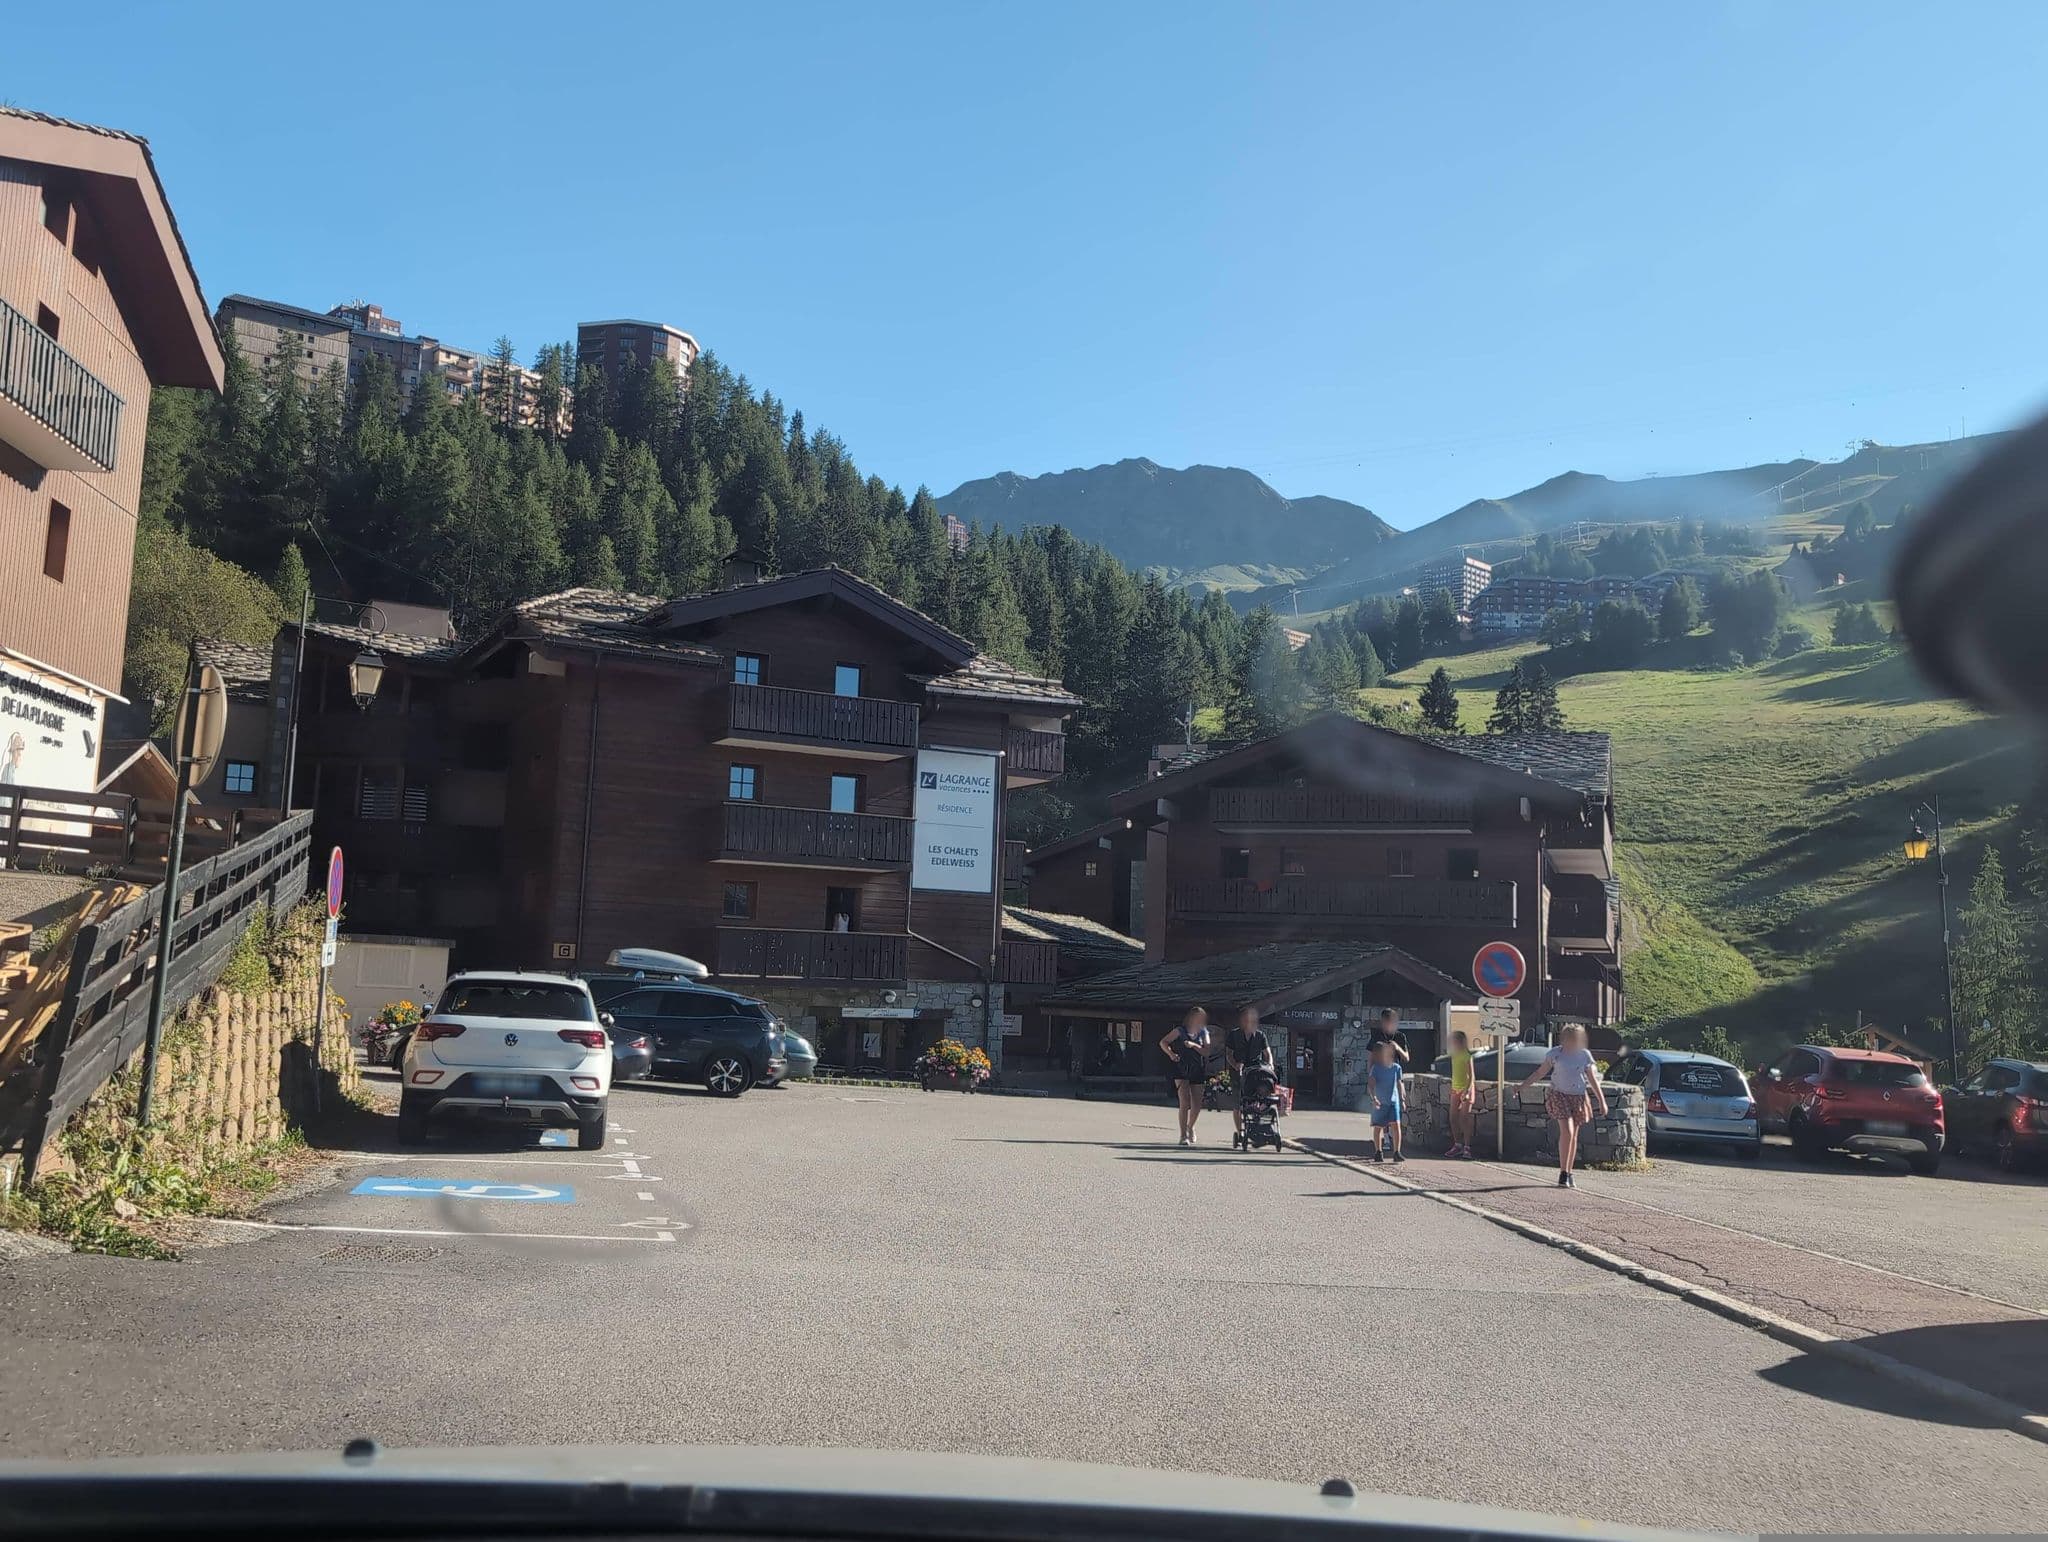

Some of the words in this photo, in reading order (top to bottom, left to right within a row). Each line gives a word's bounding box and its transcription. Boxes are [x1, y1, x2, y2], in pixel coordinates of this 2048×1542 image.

[939, 774, 991, 788] LAGRANGE
[939, 784, 971, 794] vacances
[937, 804, 973, 815] RÉSIDENCE
[928, 844, 942, 854] LES
[944, 846, 979, 857] CHALETS
[931, 856, 975, 868] EDELWEISS
[560, 946, 569, 956] G
